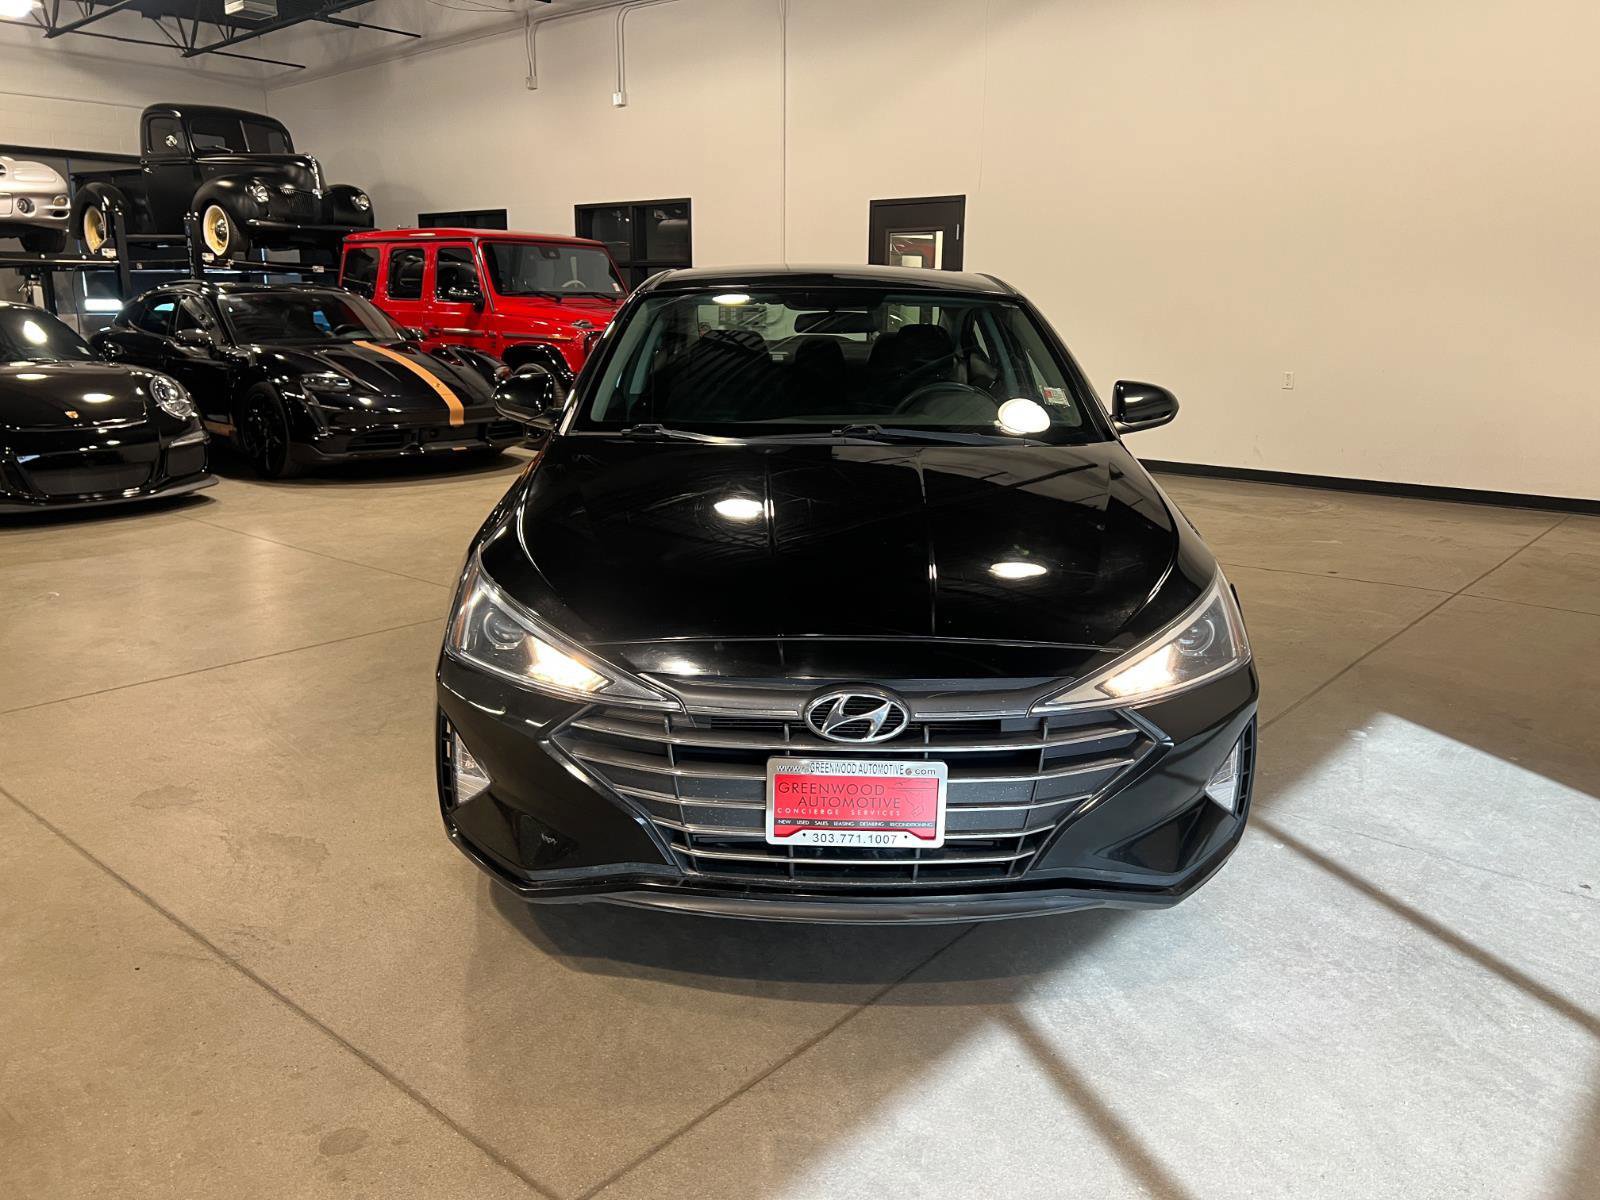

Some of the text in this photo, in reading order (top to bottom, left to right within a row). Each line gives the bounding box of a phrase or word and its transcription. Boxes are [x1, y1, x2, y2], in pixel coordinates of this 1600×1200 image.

[809, 762, 857, 774] GREENWOOD
[858, 763, 904, 775] AUTOMOTIVE
[778, 782, 885, 797] GREENWOOD
[798, 795, 901, 809] AUTOMOTIVE
[777, 807, 901, 817] CONCIERGE SERVICES
[812, 833, 898, 845] 303.771.1007
